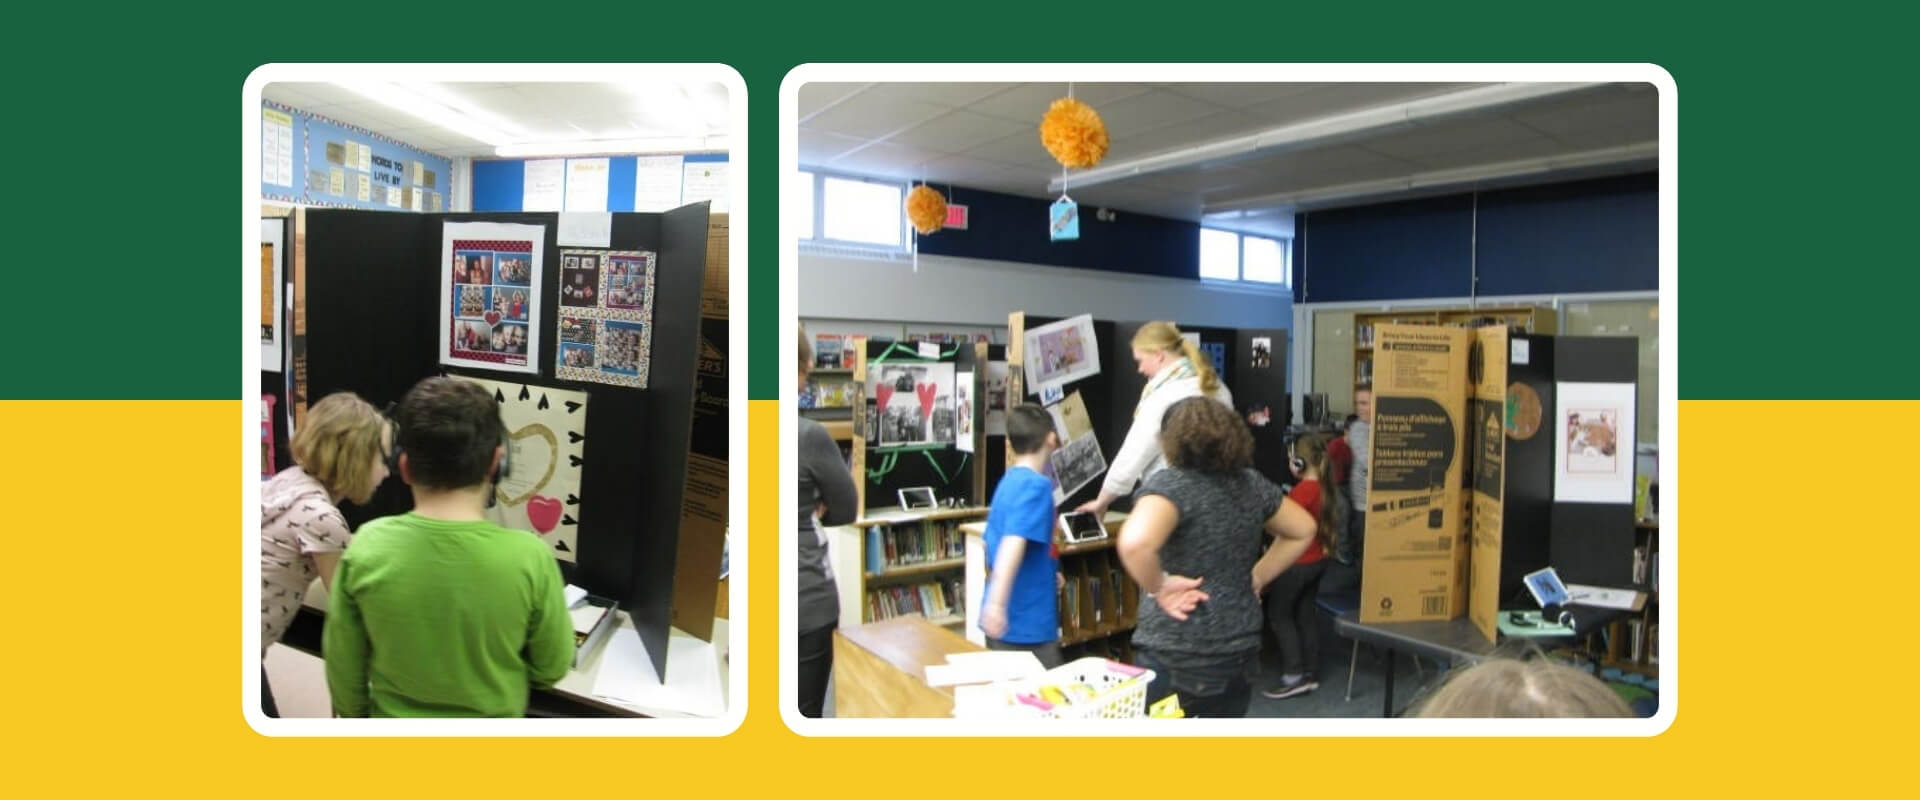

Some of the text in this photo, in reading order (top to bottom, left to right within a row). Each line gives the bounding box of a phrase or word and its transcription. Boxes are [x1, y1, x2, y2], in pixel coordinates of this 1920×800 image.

[393, 159, 403, 172] TO
[374, 172, 401, 185] LIVE BY
